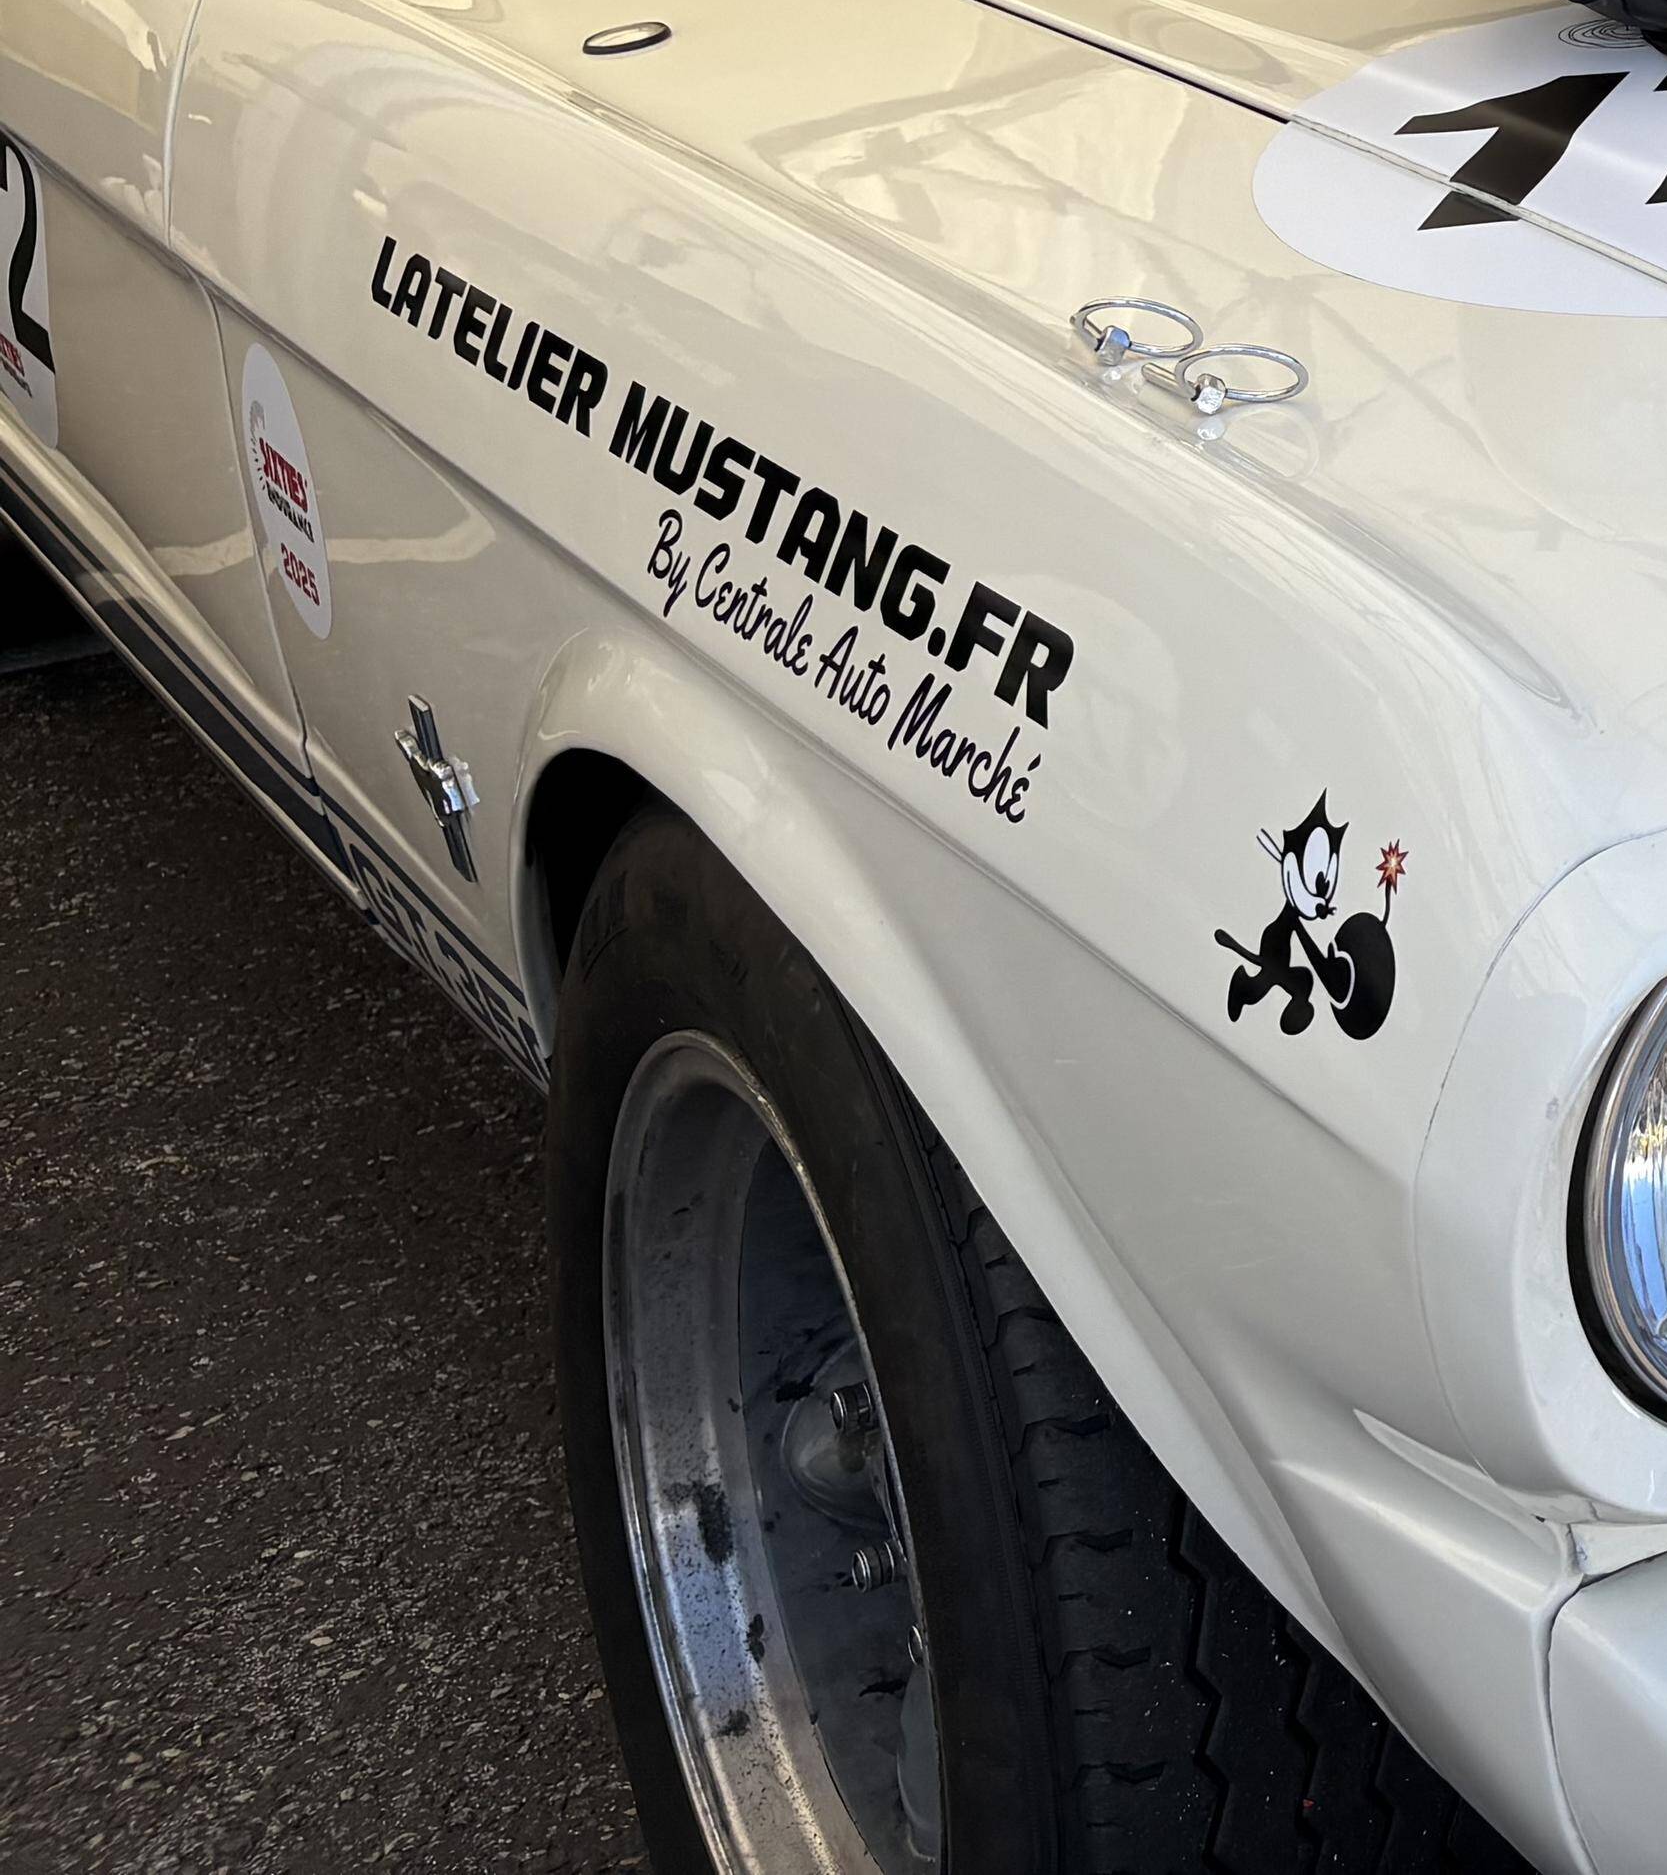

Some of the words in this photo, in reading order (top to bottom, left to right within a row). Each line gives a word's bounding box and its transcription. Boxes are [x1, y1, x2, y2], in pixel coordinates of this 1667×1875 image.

[280, 542, 320, 606] 2025
[370, 235, 609, 439] LATELIER
[607, 380, 1076, 731] MUSTANG.FR
[646, 508, 688, 617] By
[693, 542, 814, 678] Centrale
[813, 625, 891, 723] Auto
[886, 673, 1045, 825] Marché
